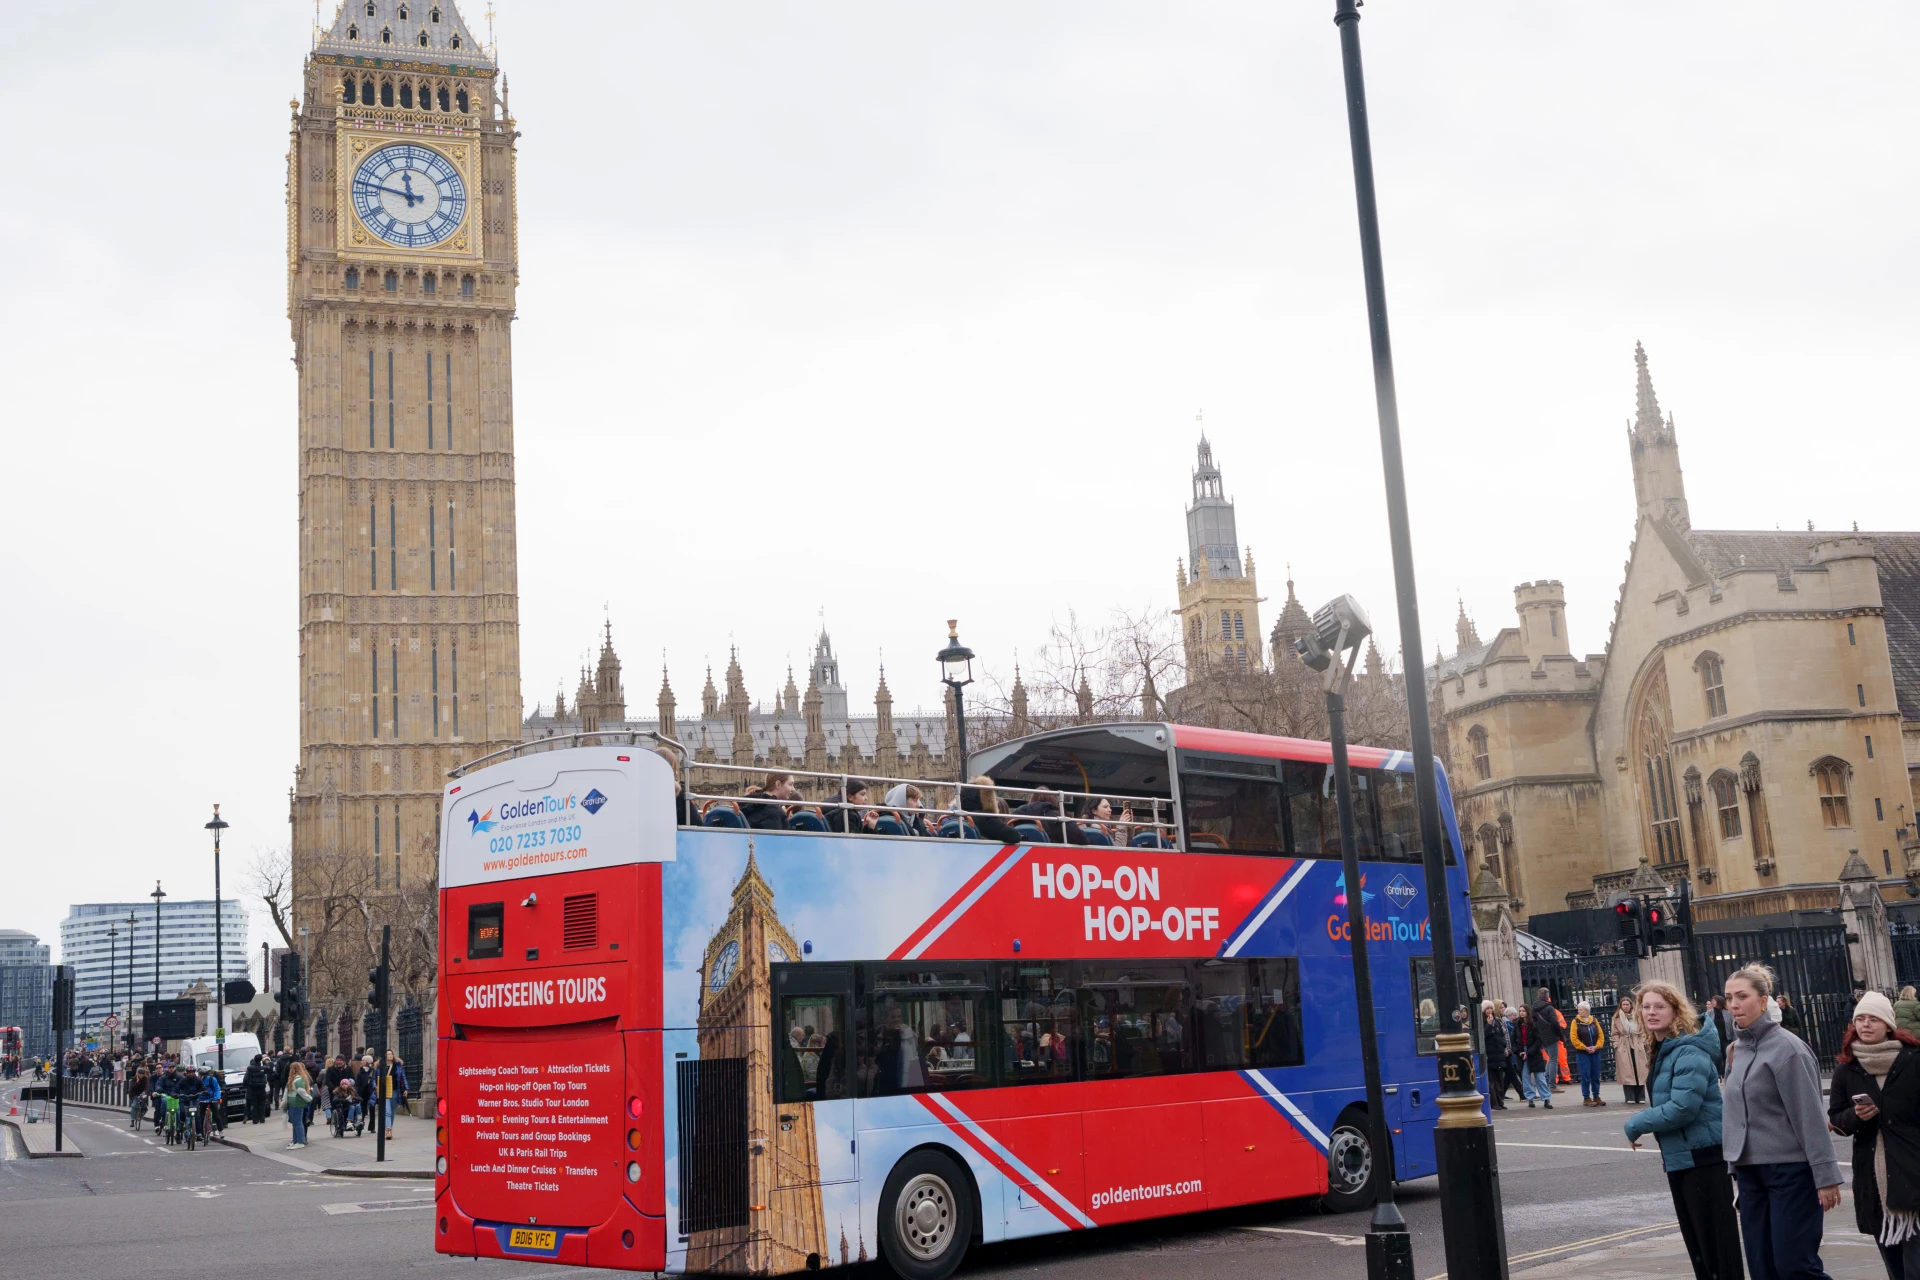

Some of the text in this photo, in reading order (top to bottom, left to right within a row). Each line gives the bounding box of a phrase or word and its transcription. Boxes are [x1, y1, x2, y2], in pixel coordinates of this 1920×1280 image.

[501, 822, 526, 832] Experience
[528, 818, 546, 826] London
[490, 825, 581, 853] 020 7233 7030
[484, 848, 587, 871] www.goldentours.com
[1032, 862, 1160, 900] HOP-ON
[1084, 906, 1219, 941] HOP-OFF
[1327, 914, 1432, 940] GodenTours
[465, 977, 606, 1009] SIGHTSEEING TOURS
[459, 1064, 610, 1076] Sightseeing Coach Tours Attraction Tickets
[480, 1082, 586, 1092] Hop-on Hop-off Open Top Tours
[478, 1099, 501, 1107] Warner
[563, 1098, 589, 1106] London
[461, 1115, 608, 1125] Bike Tours Evening Tours & Entertainment
[477, 1131, 590, 1142] Private Tours and Group Bookings
[499, 1148, 508, 1156] UK
[516, 1148, 533, 1157] Paris
[535, 1149, 547, 1157] Rail
[550, 1149, 567, 1158] Trips
[471, 1164, 597, 1175] Lunch And Dinner Cruises Transfers
[507, 1181, 559, 1191] Theatre Tickets
[1092, 1180, 1202, 1209] goldentours.com
[515, 1231, 551, 1246] BD16 YFC
